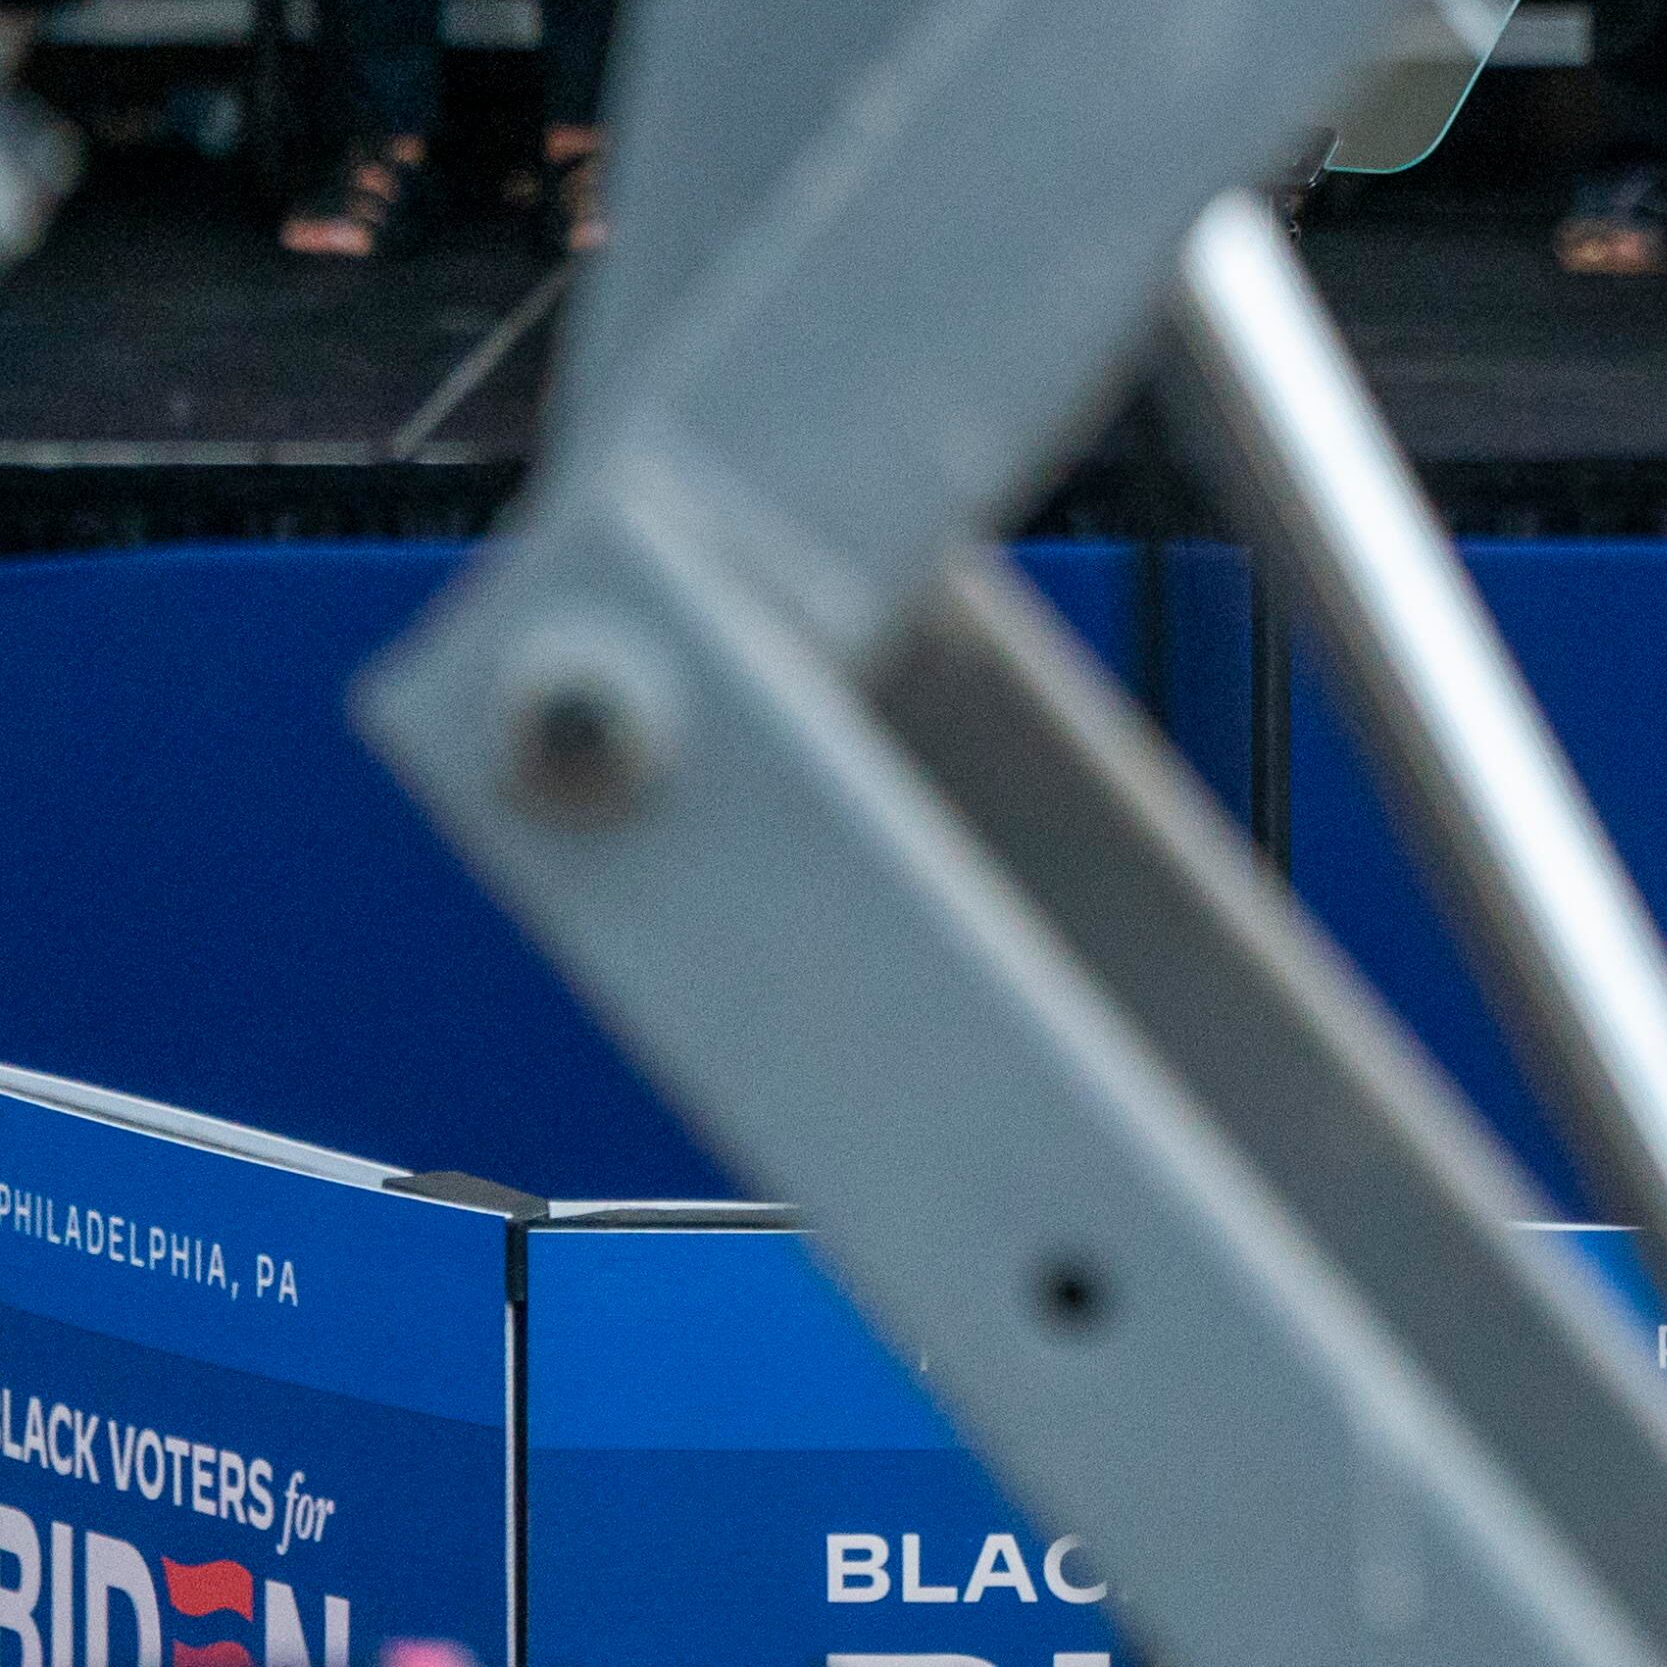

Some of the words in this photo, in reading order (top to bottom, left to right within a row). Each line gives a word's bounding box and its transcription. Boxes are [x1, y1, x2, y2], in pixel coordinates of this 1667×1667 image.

[0, 1184, 241, 1302] PHILADELPHIA,
[256, 1255, 300, 1307] PA
[0, 1388, 99, 1484] LACK
[107, 1419, 274, 1530] VOTERS
[276, 1471, 335, 1555] for
[826, 1534, 1108, 1604] BLAC
